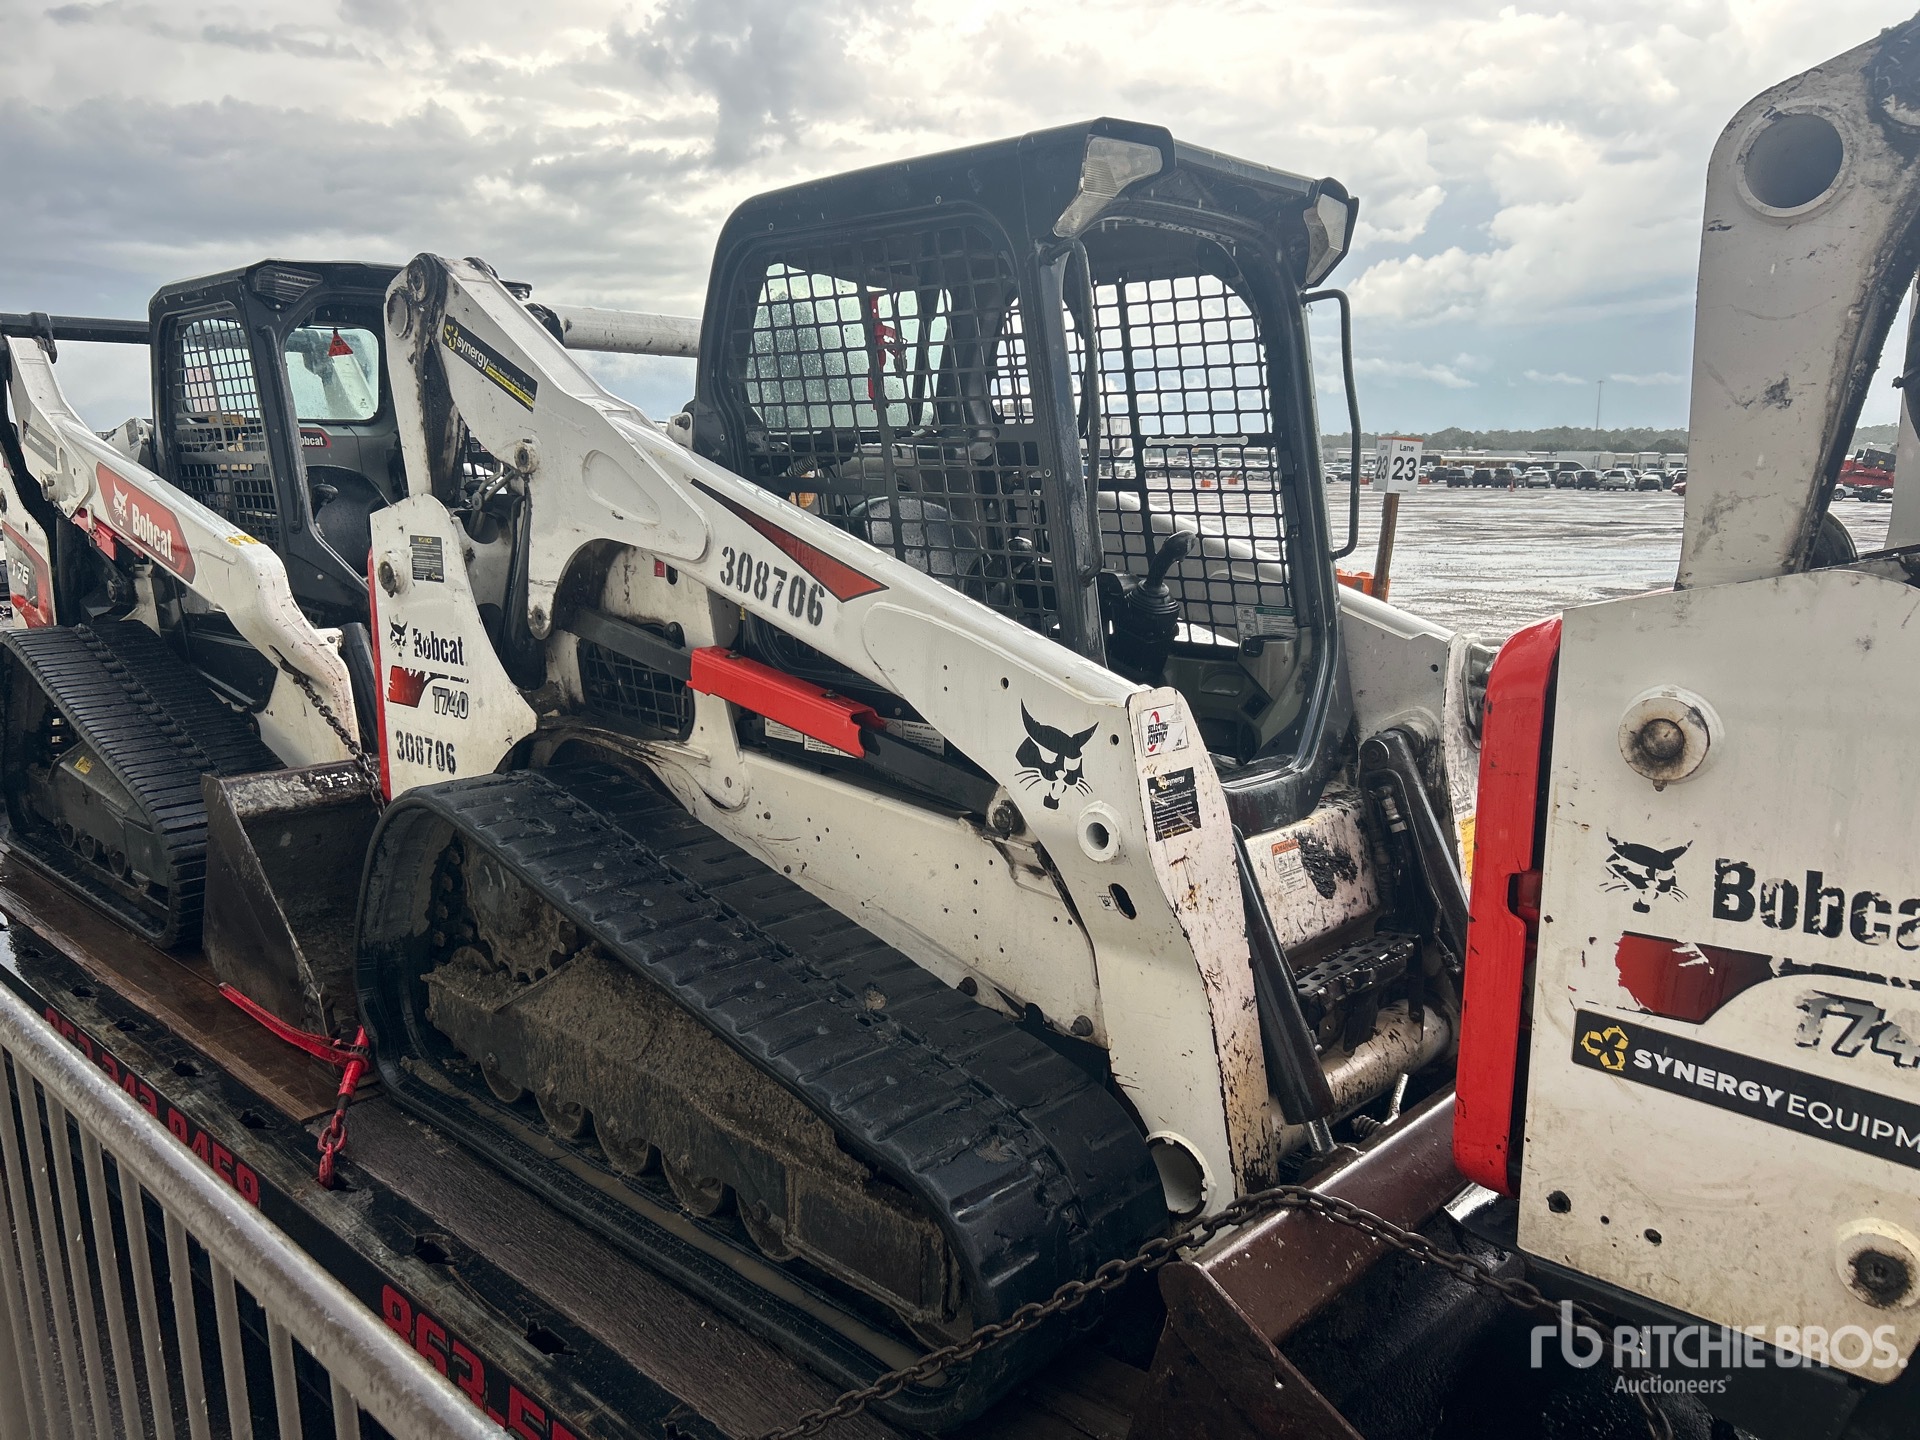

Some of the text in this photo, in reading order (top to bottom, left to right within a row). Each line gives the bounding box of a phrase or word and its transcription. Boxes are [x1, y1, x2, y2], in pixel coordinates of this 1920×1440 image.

[457, 337, 489, 370] synergy
[300, 436, 324, 446] obcat
[1399, 443, 1415, 452] Lane
[1375, 455, 1388, 480] 23
[1391, 456, 1417, 481] 23
[132, 502, 174, 563] Bobcat
[720, 546, 825, 626] 308706
[412, 628, 465, 666] Bobcat
[432, 685, 469, 719] T740
[395, 730, 457, 775] 308706
[1633, 1049, 1784, 1108] SYNERGY
